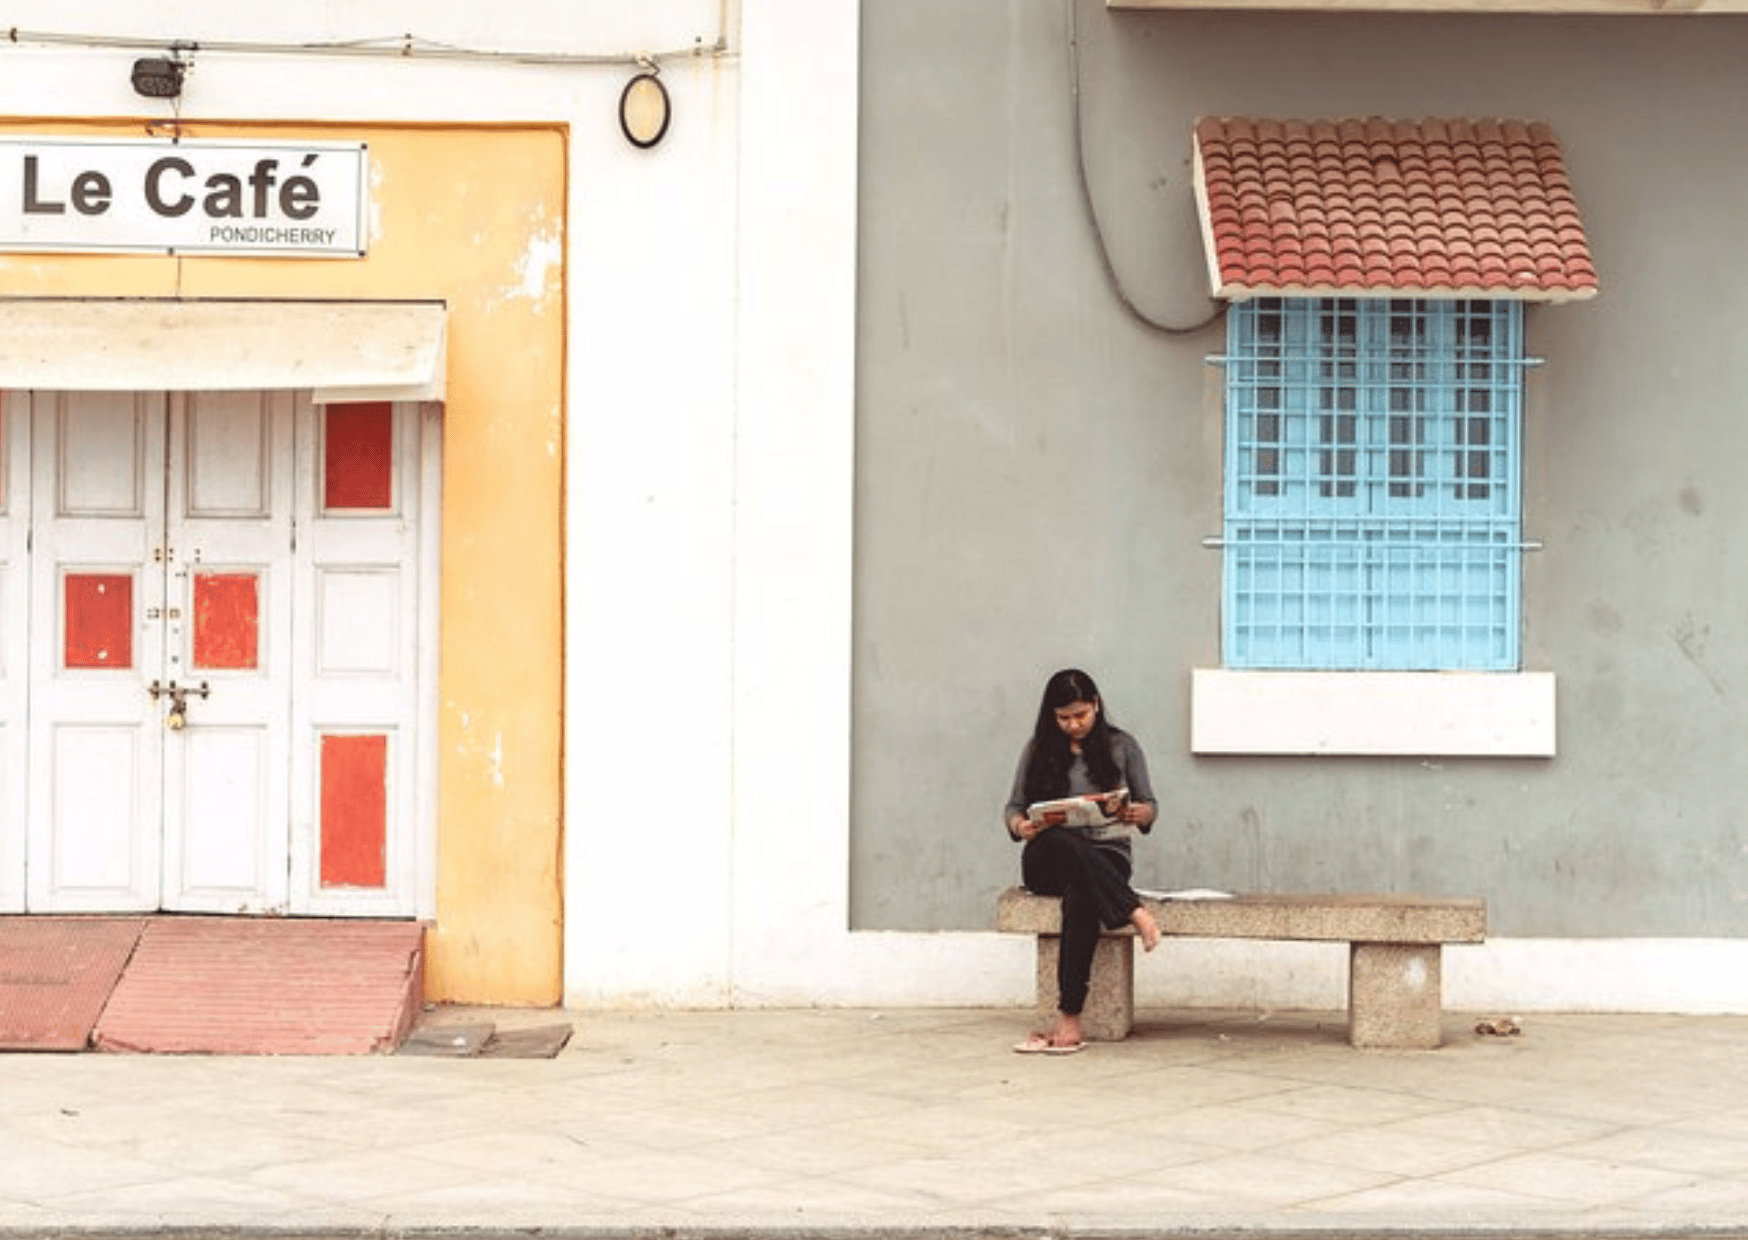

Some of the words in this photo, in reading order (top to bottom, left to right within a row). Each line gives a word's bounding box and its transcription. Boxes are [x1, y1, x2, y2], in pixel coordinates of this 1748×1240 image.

[23, 156, 112, 215] Le
[145, 154, 320, 220] Café
[210, 227, 335, 244] PONDICHERRY
